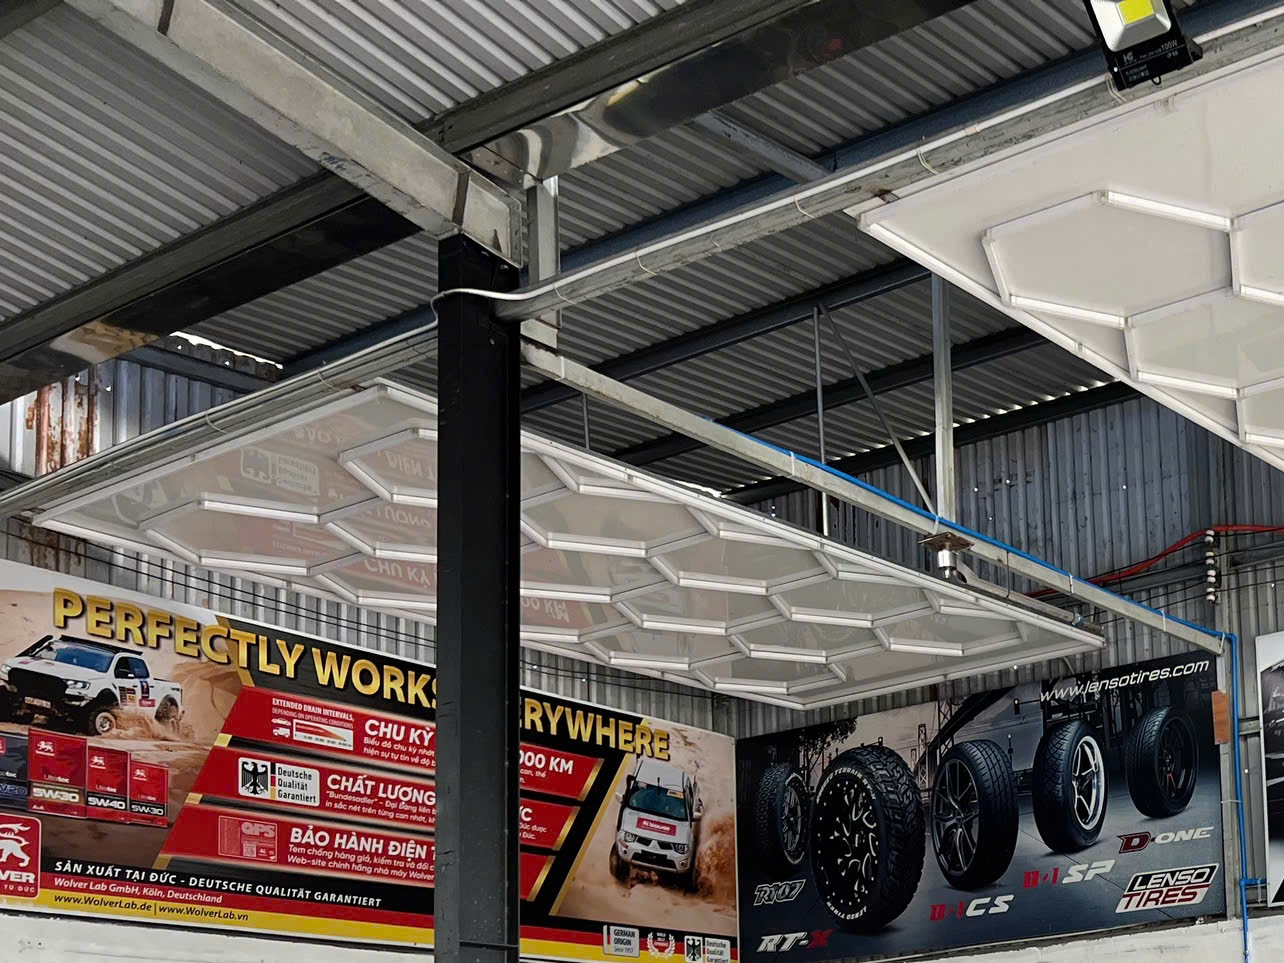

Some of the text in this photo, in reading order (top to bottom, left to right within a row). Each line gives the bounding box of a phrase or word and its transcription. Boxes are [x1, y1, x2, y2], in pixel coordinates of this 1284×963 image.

[53, 587, 669, 761] PERFECTLY WORK RYWHERE
[1040, 660, 1209, 702] www.lensotires.com
[272, 697, 302, 710] EXTENDED
[303, 704, 321, 714] DRAIN
[364, 719, 405, 741] CHU
[408, 727, 434, 747] KỲ
[277, 766, 313, 781] Deutsche
[549, 755, 574, 775] KM
[277, 778, 308, 791] Qualität
[277, 789, 317, 803] Garantiert
[327, 774, 436, 806] CHẤT LƯỢNG
[131, 804, 164, 816] 5W-30
[290, 825, 330, 847] BẢO
[334, 832, 384, 854] HÀNH
[388, 840, 427, 863] ĐIỆN
[1115, 827, 1215, 855] D-ONE
[287, 854, 327, 867] Web-site
[288, 844, 306, 854] Tem
[393, 859, 405, 868] tra
[1062, 859, 1116, 884] SP
[1132, 867, 1211, 892] LENSO
[54, 877, 223, 904] Wolver Lab GmbH, Köln, Deutschland
[55, 860, 382, 908] SẢN XUẤT TẠI ĐỨC DEUTSCHE QUALITÄT GARANTIERT
[54, 894, 249, 921] www.WolverLab.de www.WolverLab.vn
[965, 894, 1015, 917] CS
[1122, 883, 1212, 910] TIRES
[613, 928, 636, 939] GERMAN
[613, 937, 632, 946] ORIGIN
[756, 928, 835, 952] RT-X
